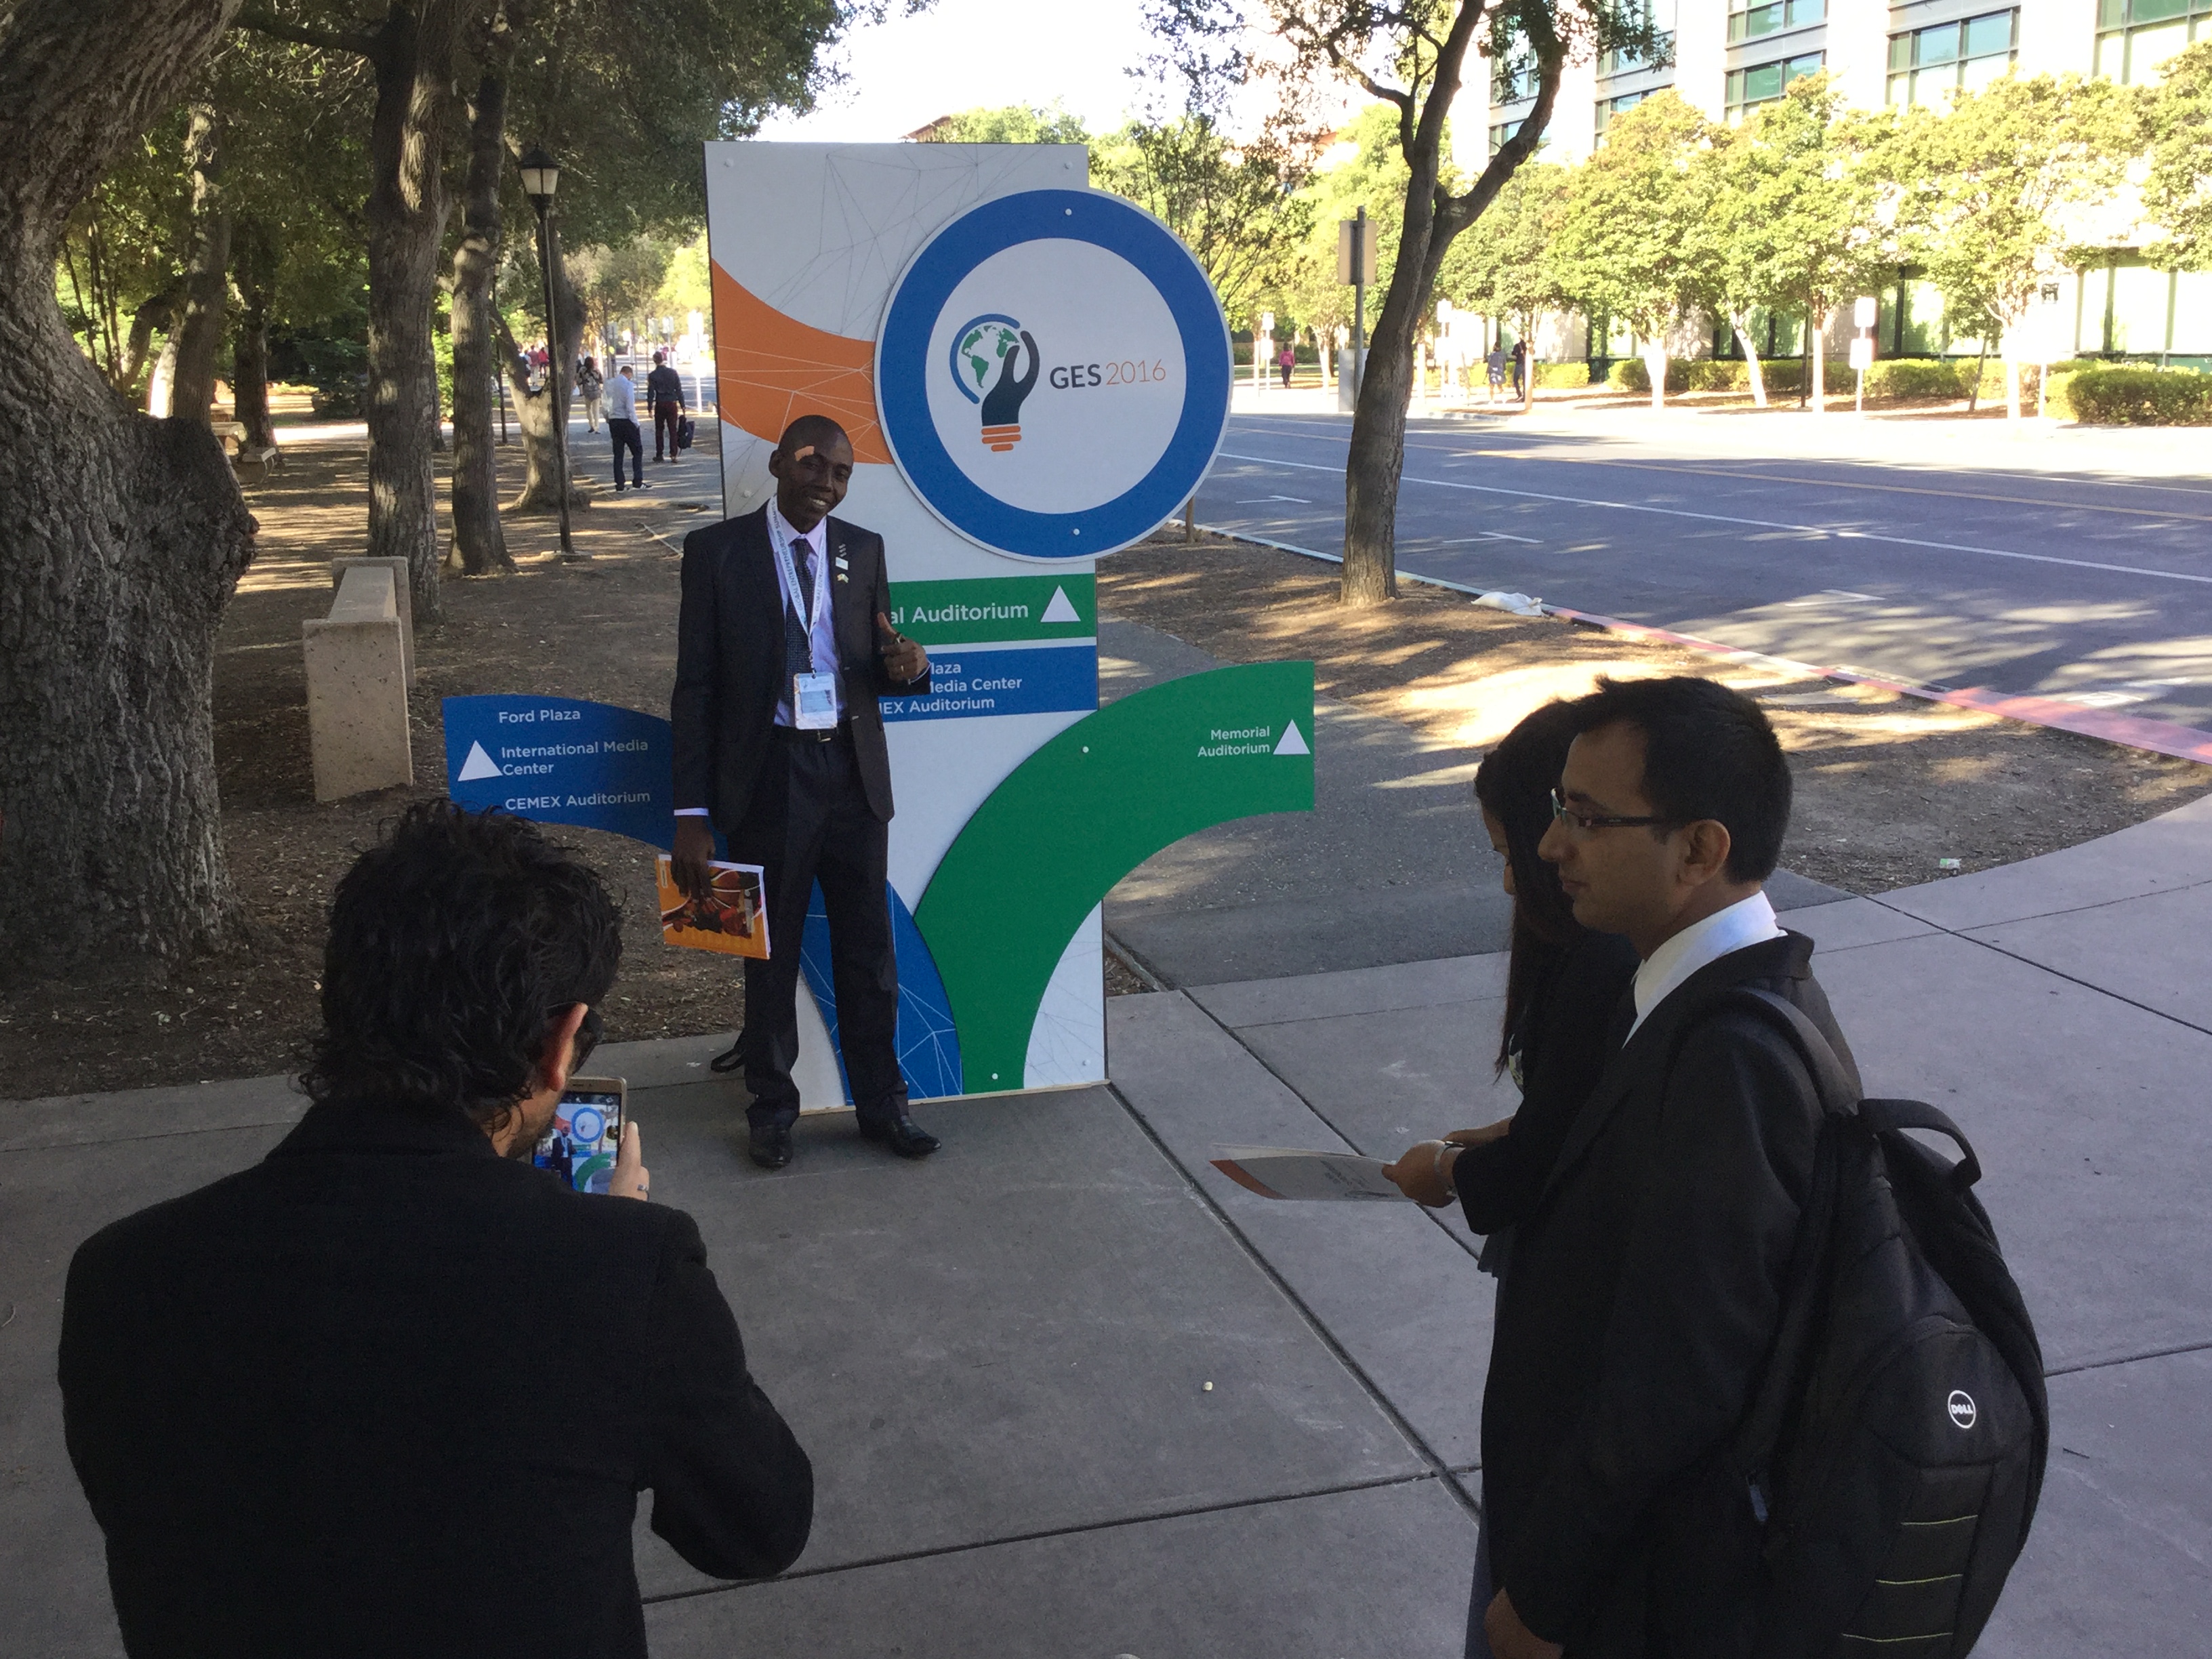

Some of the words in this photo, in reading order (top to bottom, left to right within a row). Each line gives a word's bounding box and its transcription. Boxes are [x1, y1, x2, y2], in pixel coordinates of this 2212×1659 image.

[912, 602, 1029, 623] Auditorium
[972, 678, 1023, 691] Center
[909, 697, 996, 713] Auditorium
[499, 710, 535, 723] Ford
[540, 709, 581, 721] Plaza
[1210, 726, 1271, 741] Memorial
[501, 741, 599, 759] International
[603, 739, 649, 754] Media
[1197, 743, 1271, 758] Auditorium
[502, 762, 554, 776] Center
[505, 796, 562, 811] CEMEX
[566, 791, 651, 807] Auditorium
[1950, 1404, 1974, 1415] DELL
